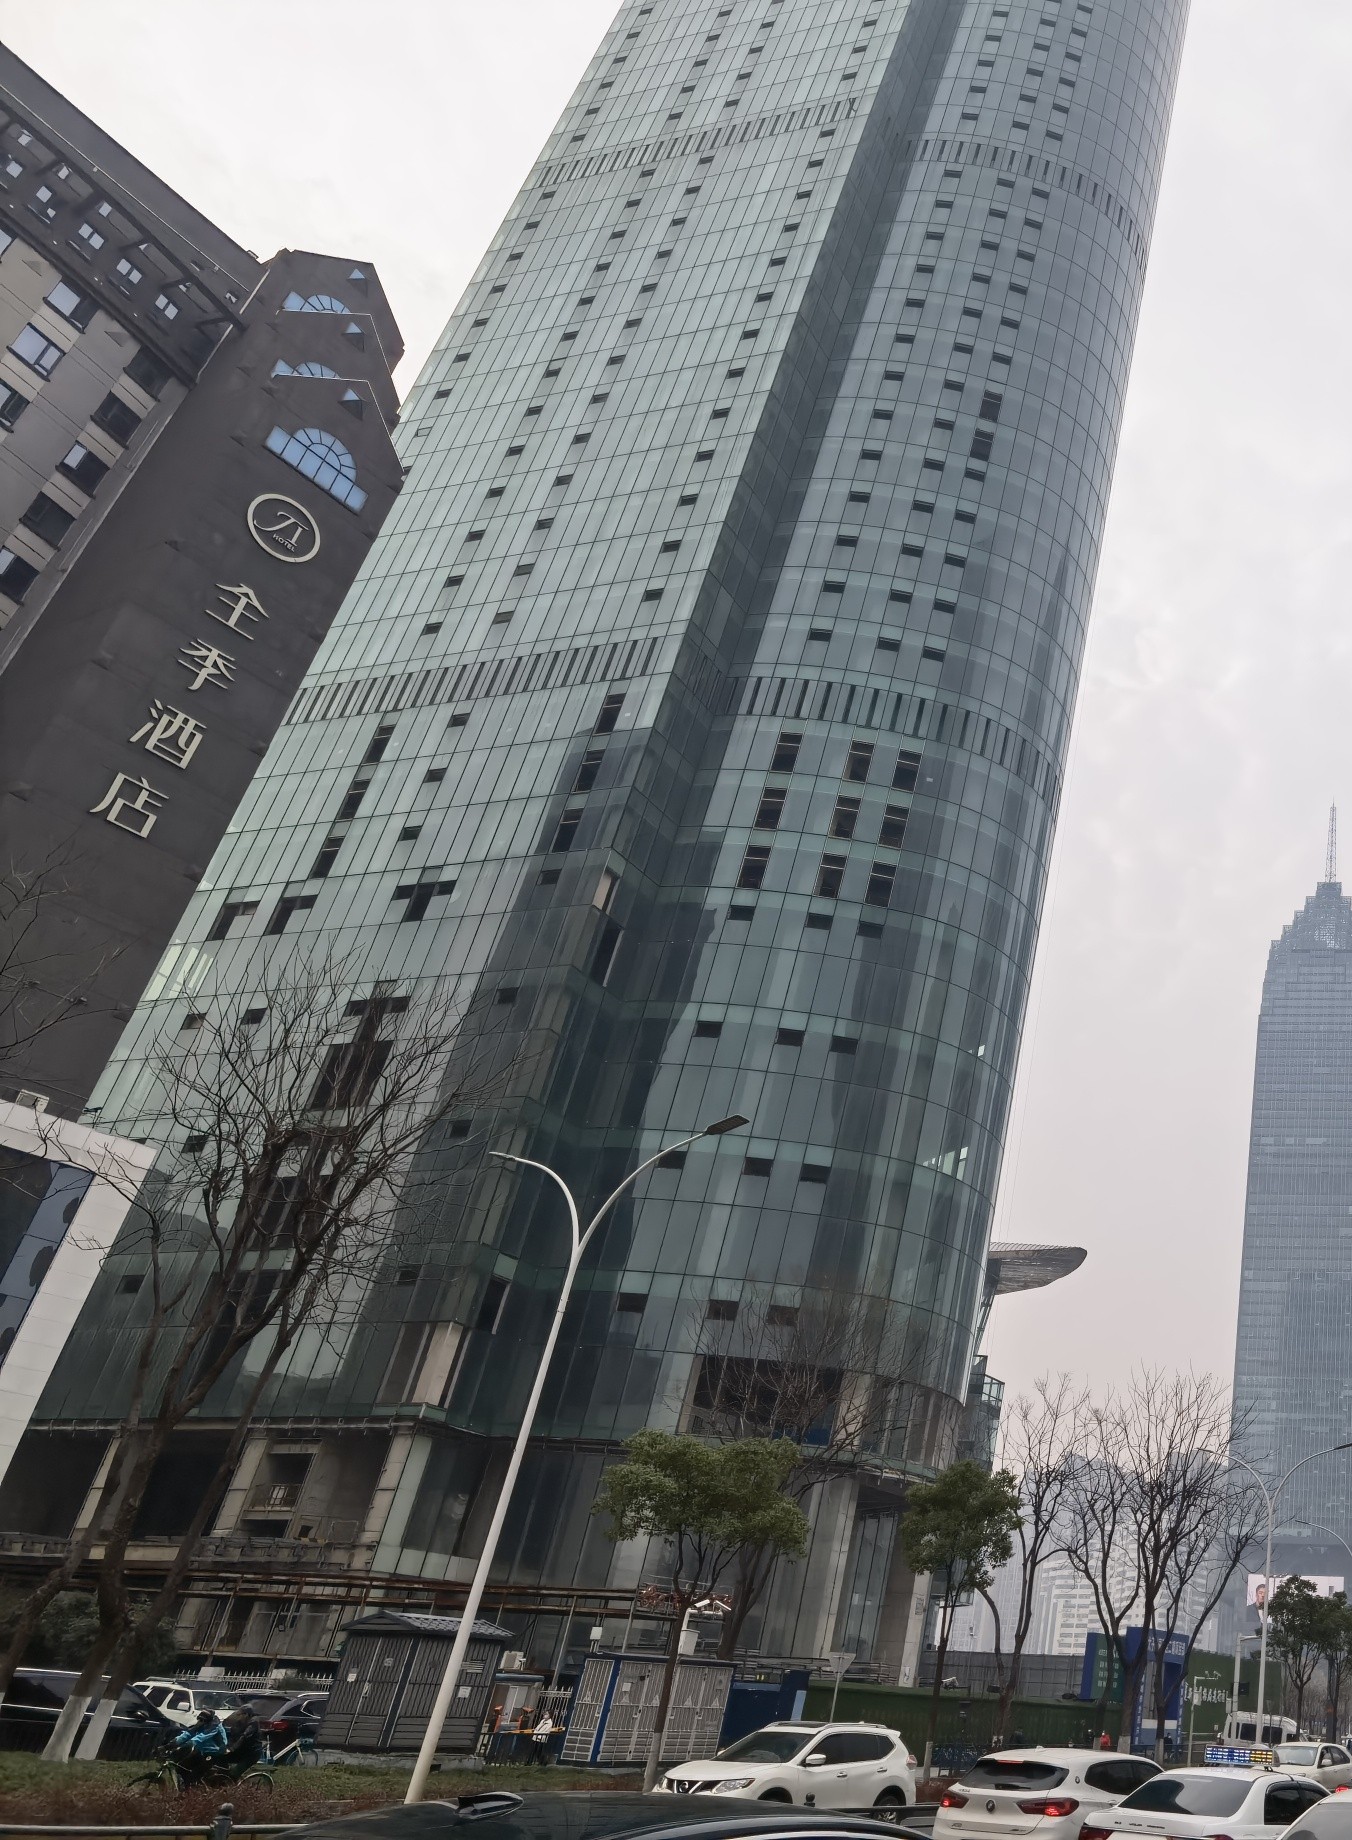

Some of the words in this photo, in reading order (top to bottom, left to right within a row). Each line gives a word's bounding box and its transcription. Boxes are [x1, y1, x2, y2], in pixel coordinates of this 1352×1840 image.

[272, 533, 296, 553] HOTEL
[90, 582, 271, 839] 全季酒店
